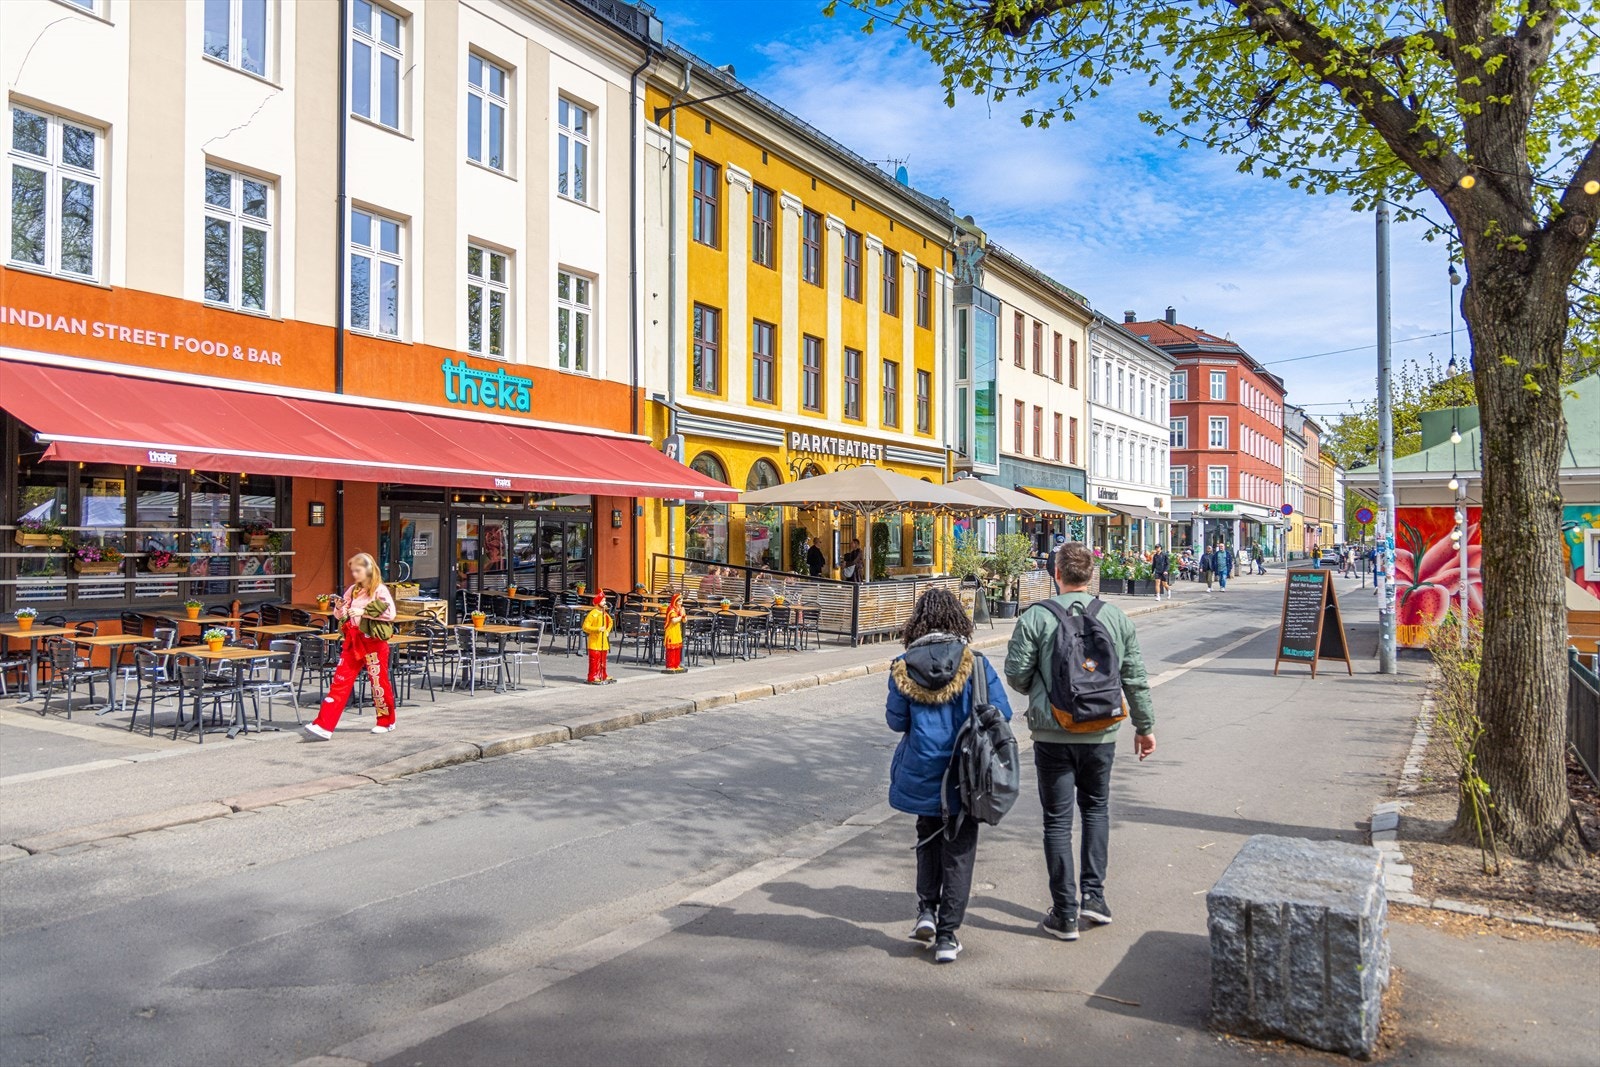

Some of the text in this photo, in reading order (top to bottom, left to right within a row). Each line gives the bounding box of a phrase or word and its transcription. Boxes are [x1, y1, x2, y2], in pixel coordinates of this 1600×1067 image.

[1, 306, 282, 366] INDIAN STREET FOOD & BAR
[441, 357, 533, 412] theka
[791, 431, 884, 460] PARKTEATRET
